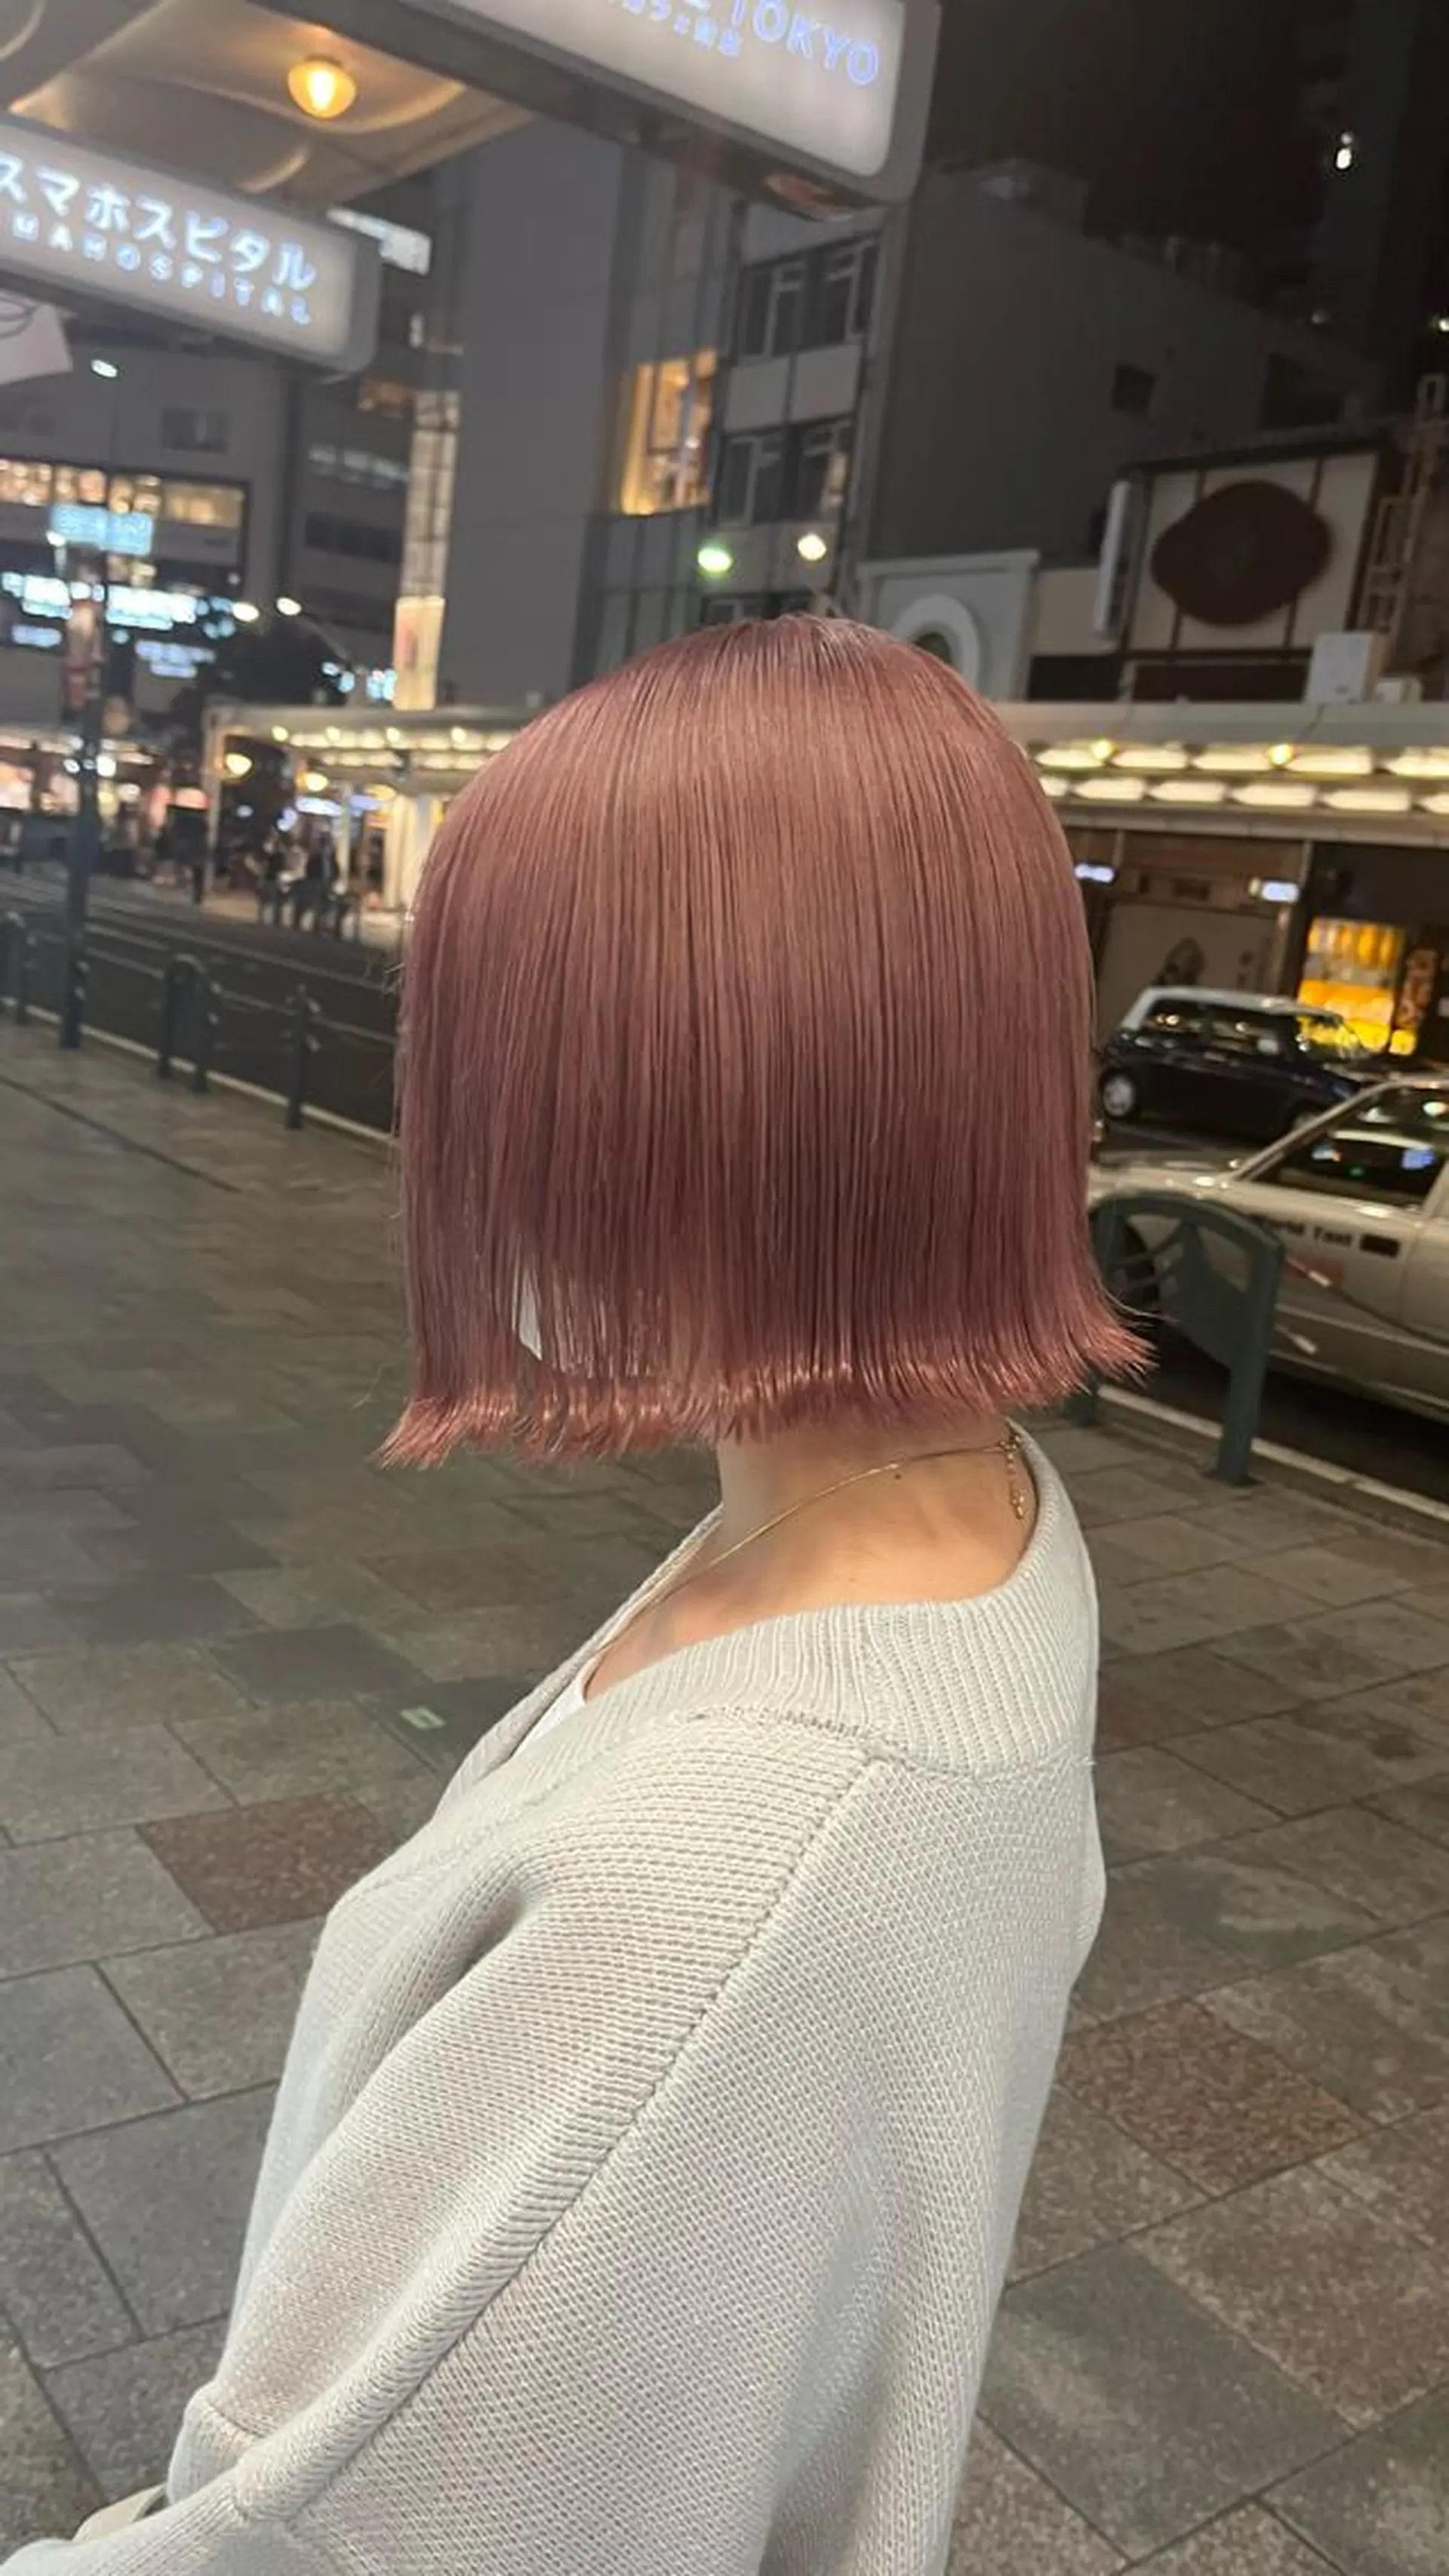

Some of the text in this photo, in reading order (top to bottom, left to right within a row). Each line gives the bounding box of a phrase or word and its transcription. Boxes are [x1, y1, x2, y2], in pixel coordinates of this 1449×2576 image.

[0, 153, 317, 291] スマホスピタル
